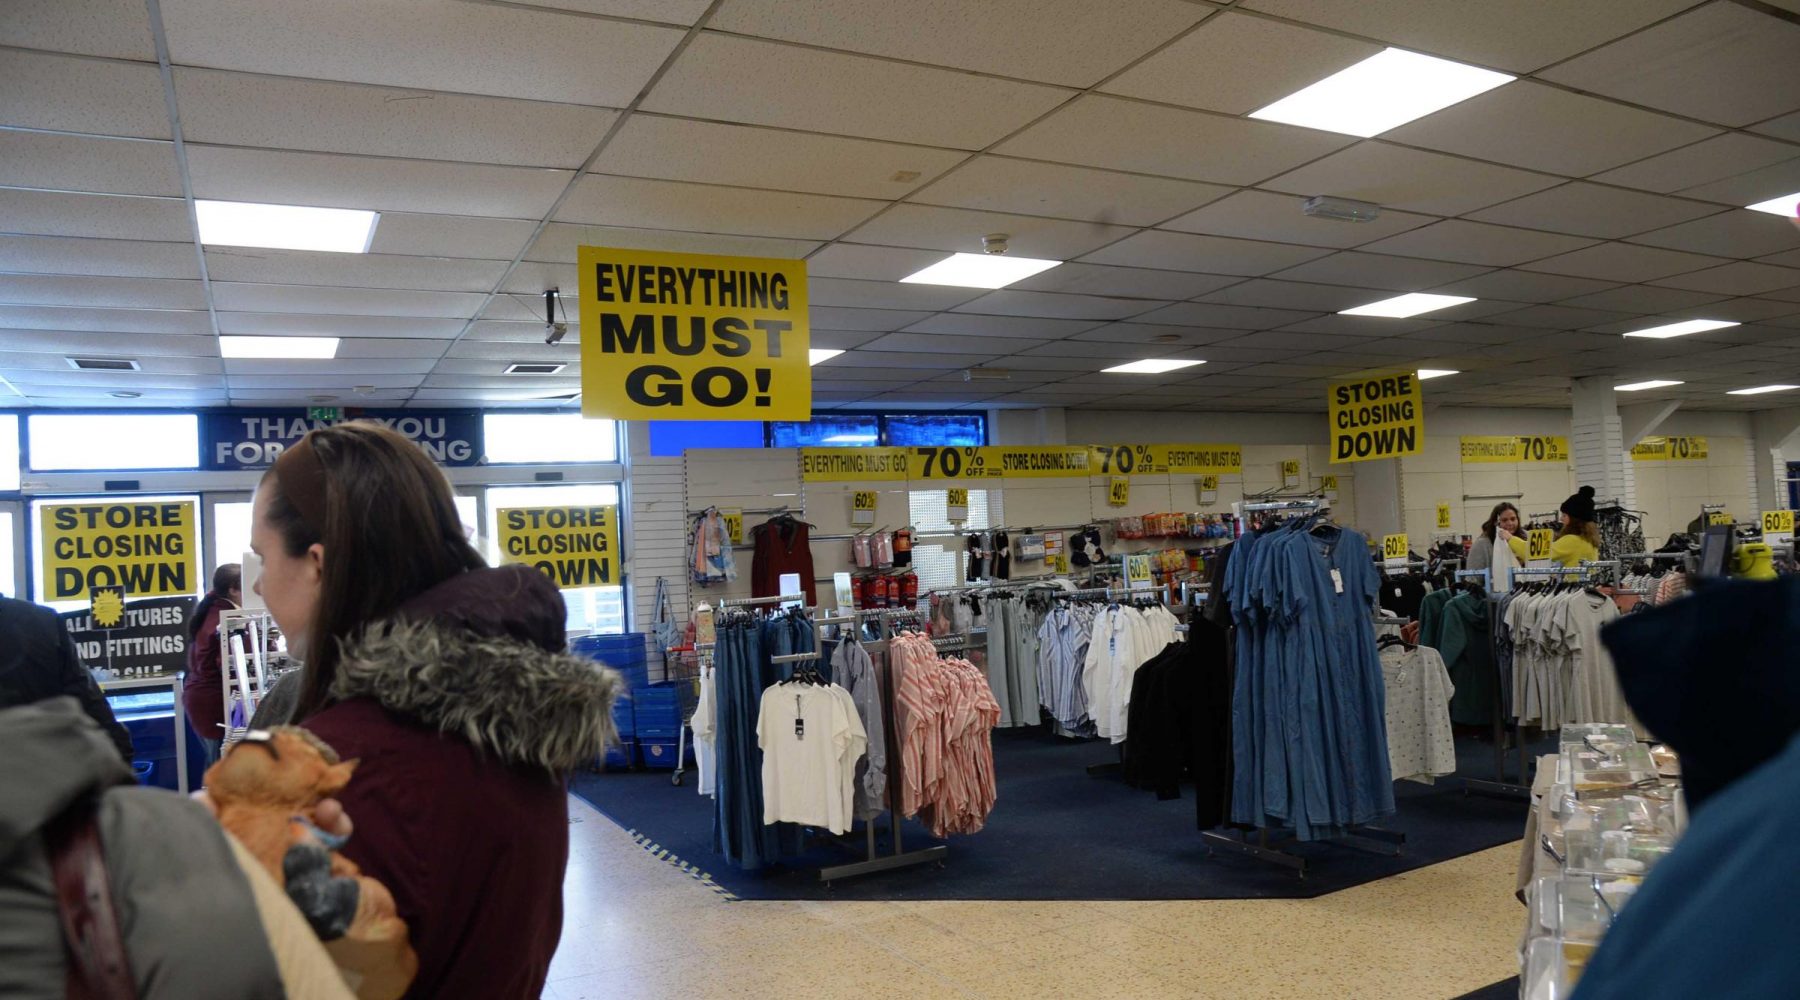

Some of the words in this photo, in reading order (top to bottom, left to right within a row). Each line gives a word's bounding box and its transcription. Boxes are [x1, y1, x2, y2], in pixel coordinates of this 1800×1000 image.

[596, 263, 789, 310] EVERYTHING
[601, 313, 793, 358] MUST
[625, 365, 772, 408] GO!
[1336, 375, 1412, 405] STORE
[1337, 400, 1414, 429] CLOSING
[242, 417, 345, 439] THAN
[216, 441, 284, 464] FOR
[1337, 426, 1415, 459] DOWN
[1461, 442, 1493, 457] EVERYTHING
[803, 455, 863, 473] EVERYTHING
[865, 455, 890, 473] MUST
[892, 455, 906, 473] GO
[917, 447, 984, 478] 70%
[1002, 453, 1029, 470] STORE
[1031, 452, 1066, 470] CLOSING
[1097, 445, 1153, 474] 70%
[1168, 451, 1211, 467] EVERYTHING
[1211, 451, 1227, 467] MUST
[1228, 451, 1241, 467] GO
[966, 468, 985, 477] OFF
[55, 505, 182, 530] STORE
[508, 507, 606, 530] STORE
[1765, 513, 1791, 530] 60%
[55, 533, 184, 560] CLOSING
[508, 532, 608, 556] CLOSING
[56, 562, 186, 597] DOWN
[534, 558, 609, 586] OWN
[127, 606, 184, 627] TURES
[77, 641, 101, 659] ND
[107, 635, 185, 658] FITTINGS
